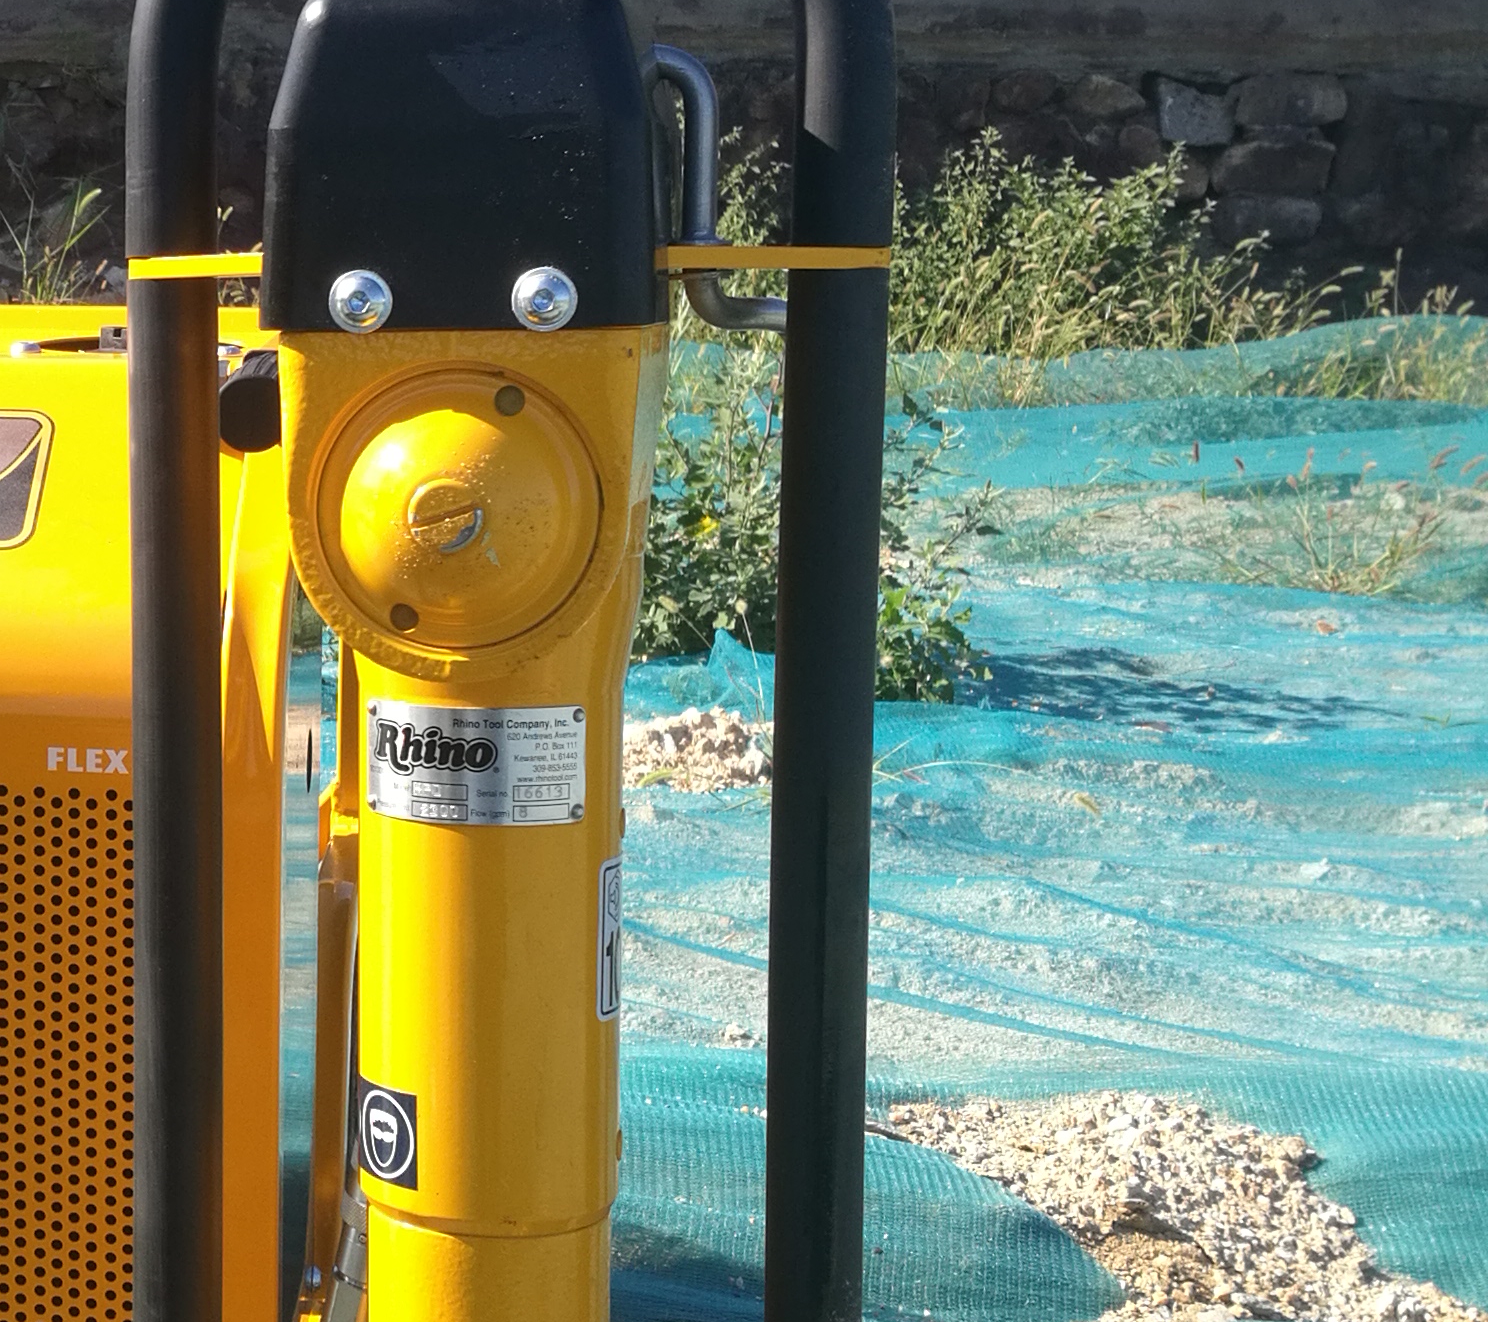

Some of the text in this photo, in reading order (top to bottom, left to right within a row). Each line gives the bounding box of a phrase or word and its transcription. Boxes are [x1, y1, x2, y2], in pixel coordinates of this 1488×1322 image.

[452, 718, 569, 731] Rhino Tool Company, Inc.
[376, 719, 498, 775] Rhino
[552, 742, 565, 750] Box
[567, 741, 578, 749] 111
[46, 746, 129, 774] FLEX
[476, 789, 498, 798] Serial
[515, 785, 564, 799] 16613
[470, 808, 487, 818] Flow
[518, 807, 528, 819] 8
